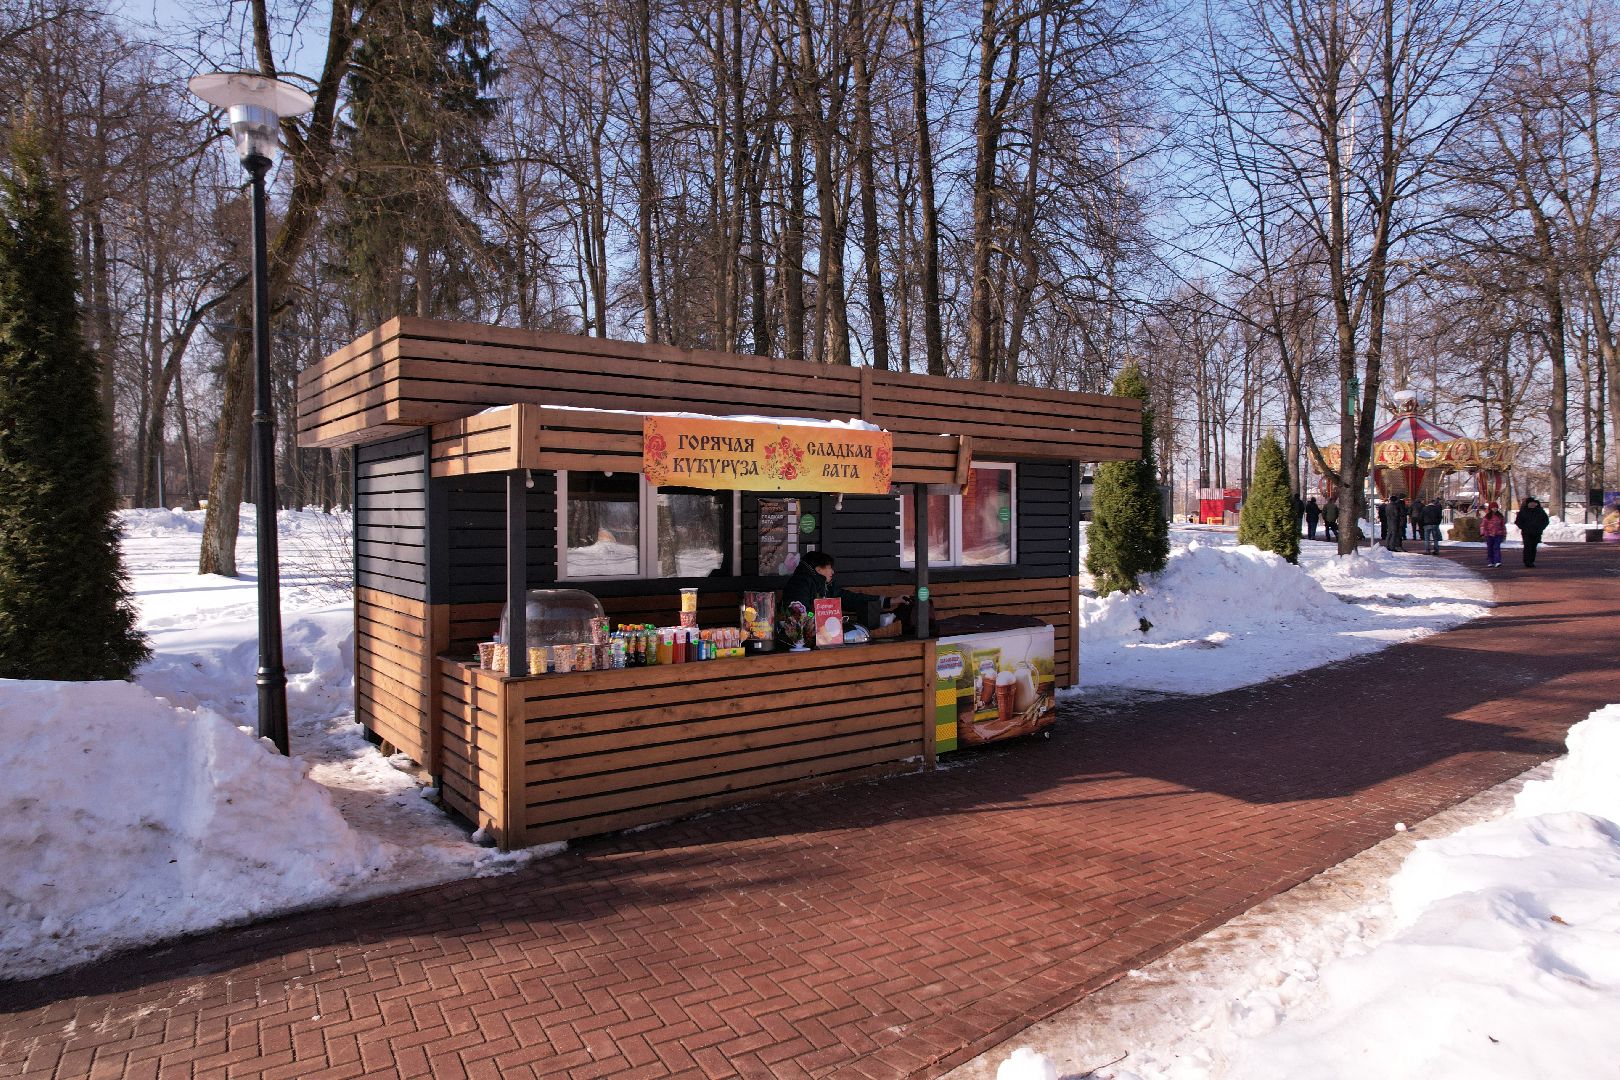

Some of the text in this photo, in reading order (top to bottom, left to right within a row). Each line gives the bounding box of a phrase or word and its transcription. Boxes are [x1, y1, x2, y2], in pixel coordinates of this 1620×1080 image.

[678, 434, 755, 452] ГОРЯЧАЯ
[807, 441, 872, 460] СЛАДКАЯ
[672, 457, 760, 479] КУКУРУЗА
[822, 463, 860, 479] ВАТА
